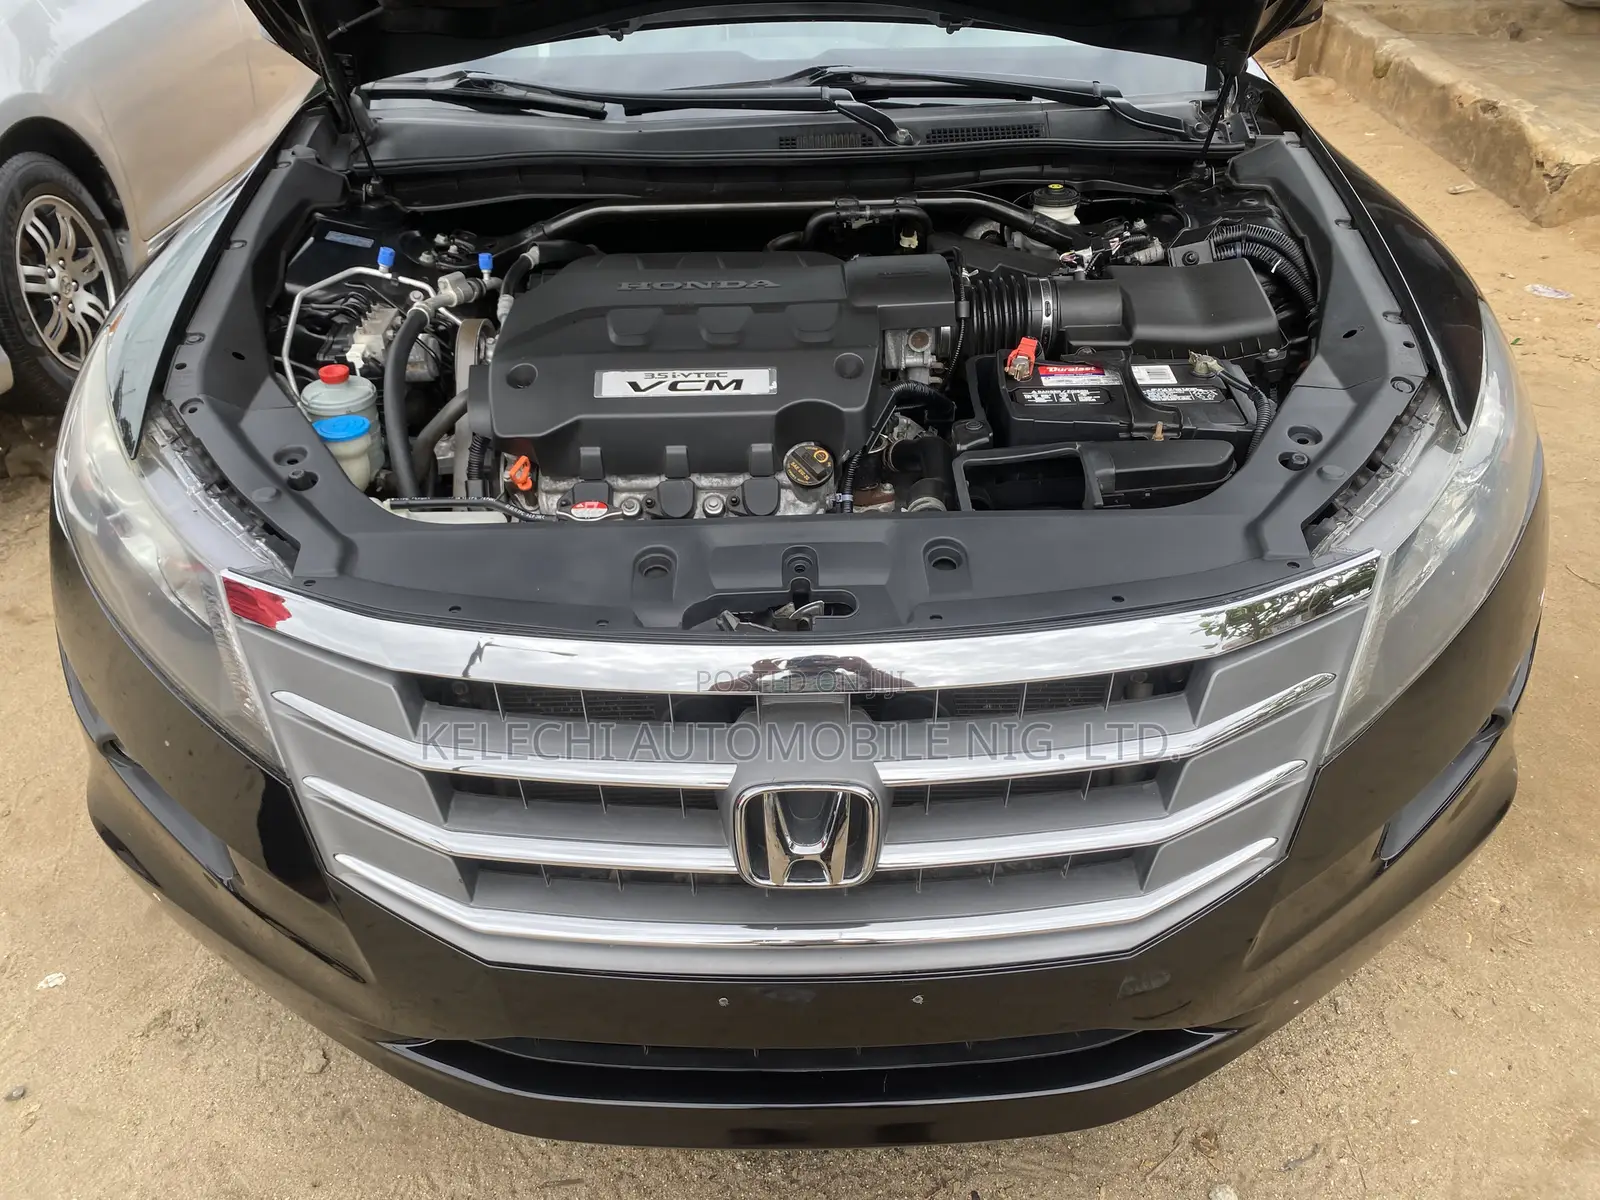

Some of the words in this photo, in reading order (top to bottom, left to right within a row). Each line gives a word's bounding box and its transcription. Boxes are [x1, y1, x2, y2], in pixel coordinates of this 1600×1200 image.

[617, 279, 781, 291] HONDA
[644, 372, 668, 380] 3.5
[671, 371, 728, 379] i-VTEC
[626, 378, 744, 393] VCM
